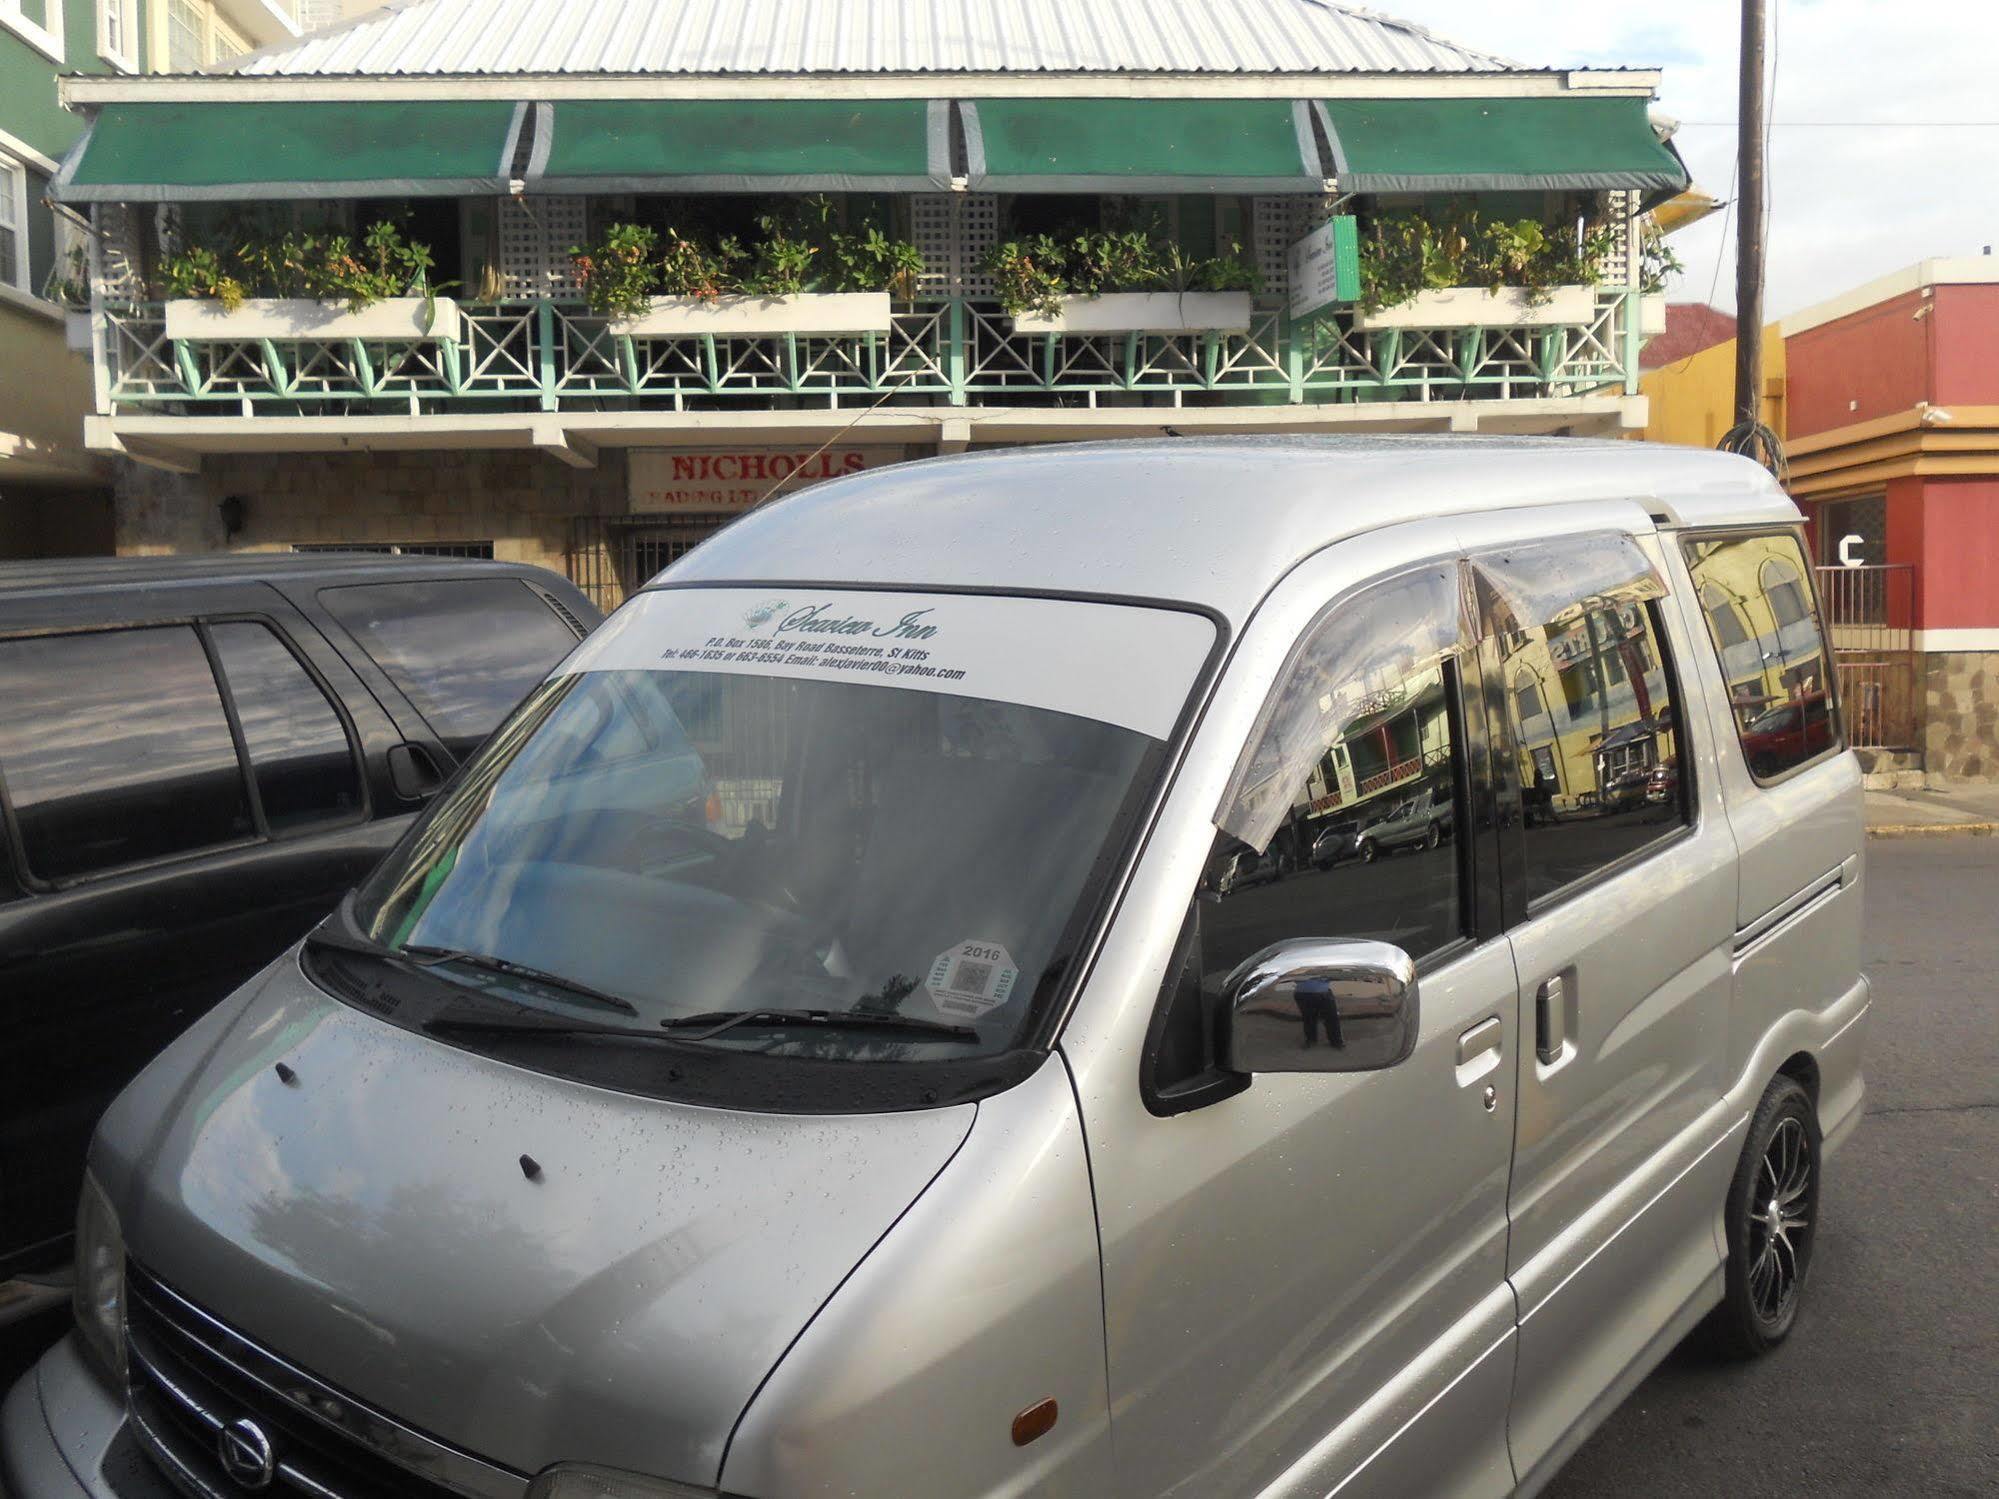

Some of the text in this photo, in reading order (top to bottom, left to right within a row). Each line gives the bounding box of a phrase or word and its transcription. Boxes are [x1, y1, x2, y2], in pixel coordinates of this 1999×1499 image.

[672, 453, 865, 481] NICHOLLS
[1838, 534, 1865, 568] C
[774, 603, 938, 640] Seaview Inn
[661, 648, 679, 660] Tel:
[723, 652, 736, 661] or
[784, 653, 820, 667] Email:
[819, 656, 965, 679] alexjavier00@yahoo.com
[705, 637, 723, 647] P.O.
[725, 638, 745, 649] Box
[774, 640, 796, 652] Bay
[795, 641, 825, 653] Road
[824, 642, 884, 658] Basseterre,
[887, 647, 903, 658] St
[903, 648, 930, 661] Kitts
[962, 944, 1001, 962] 2016
